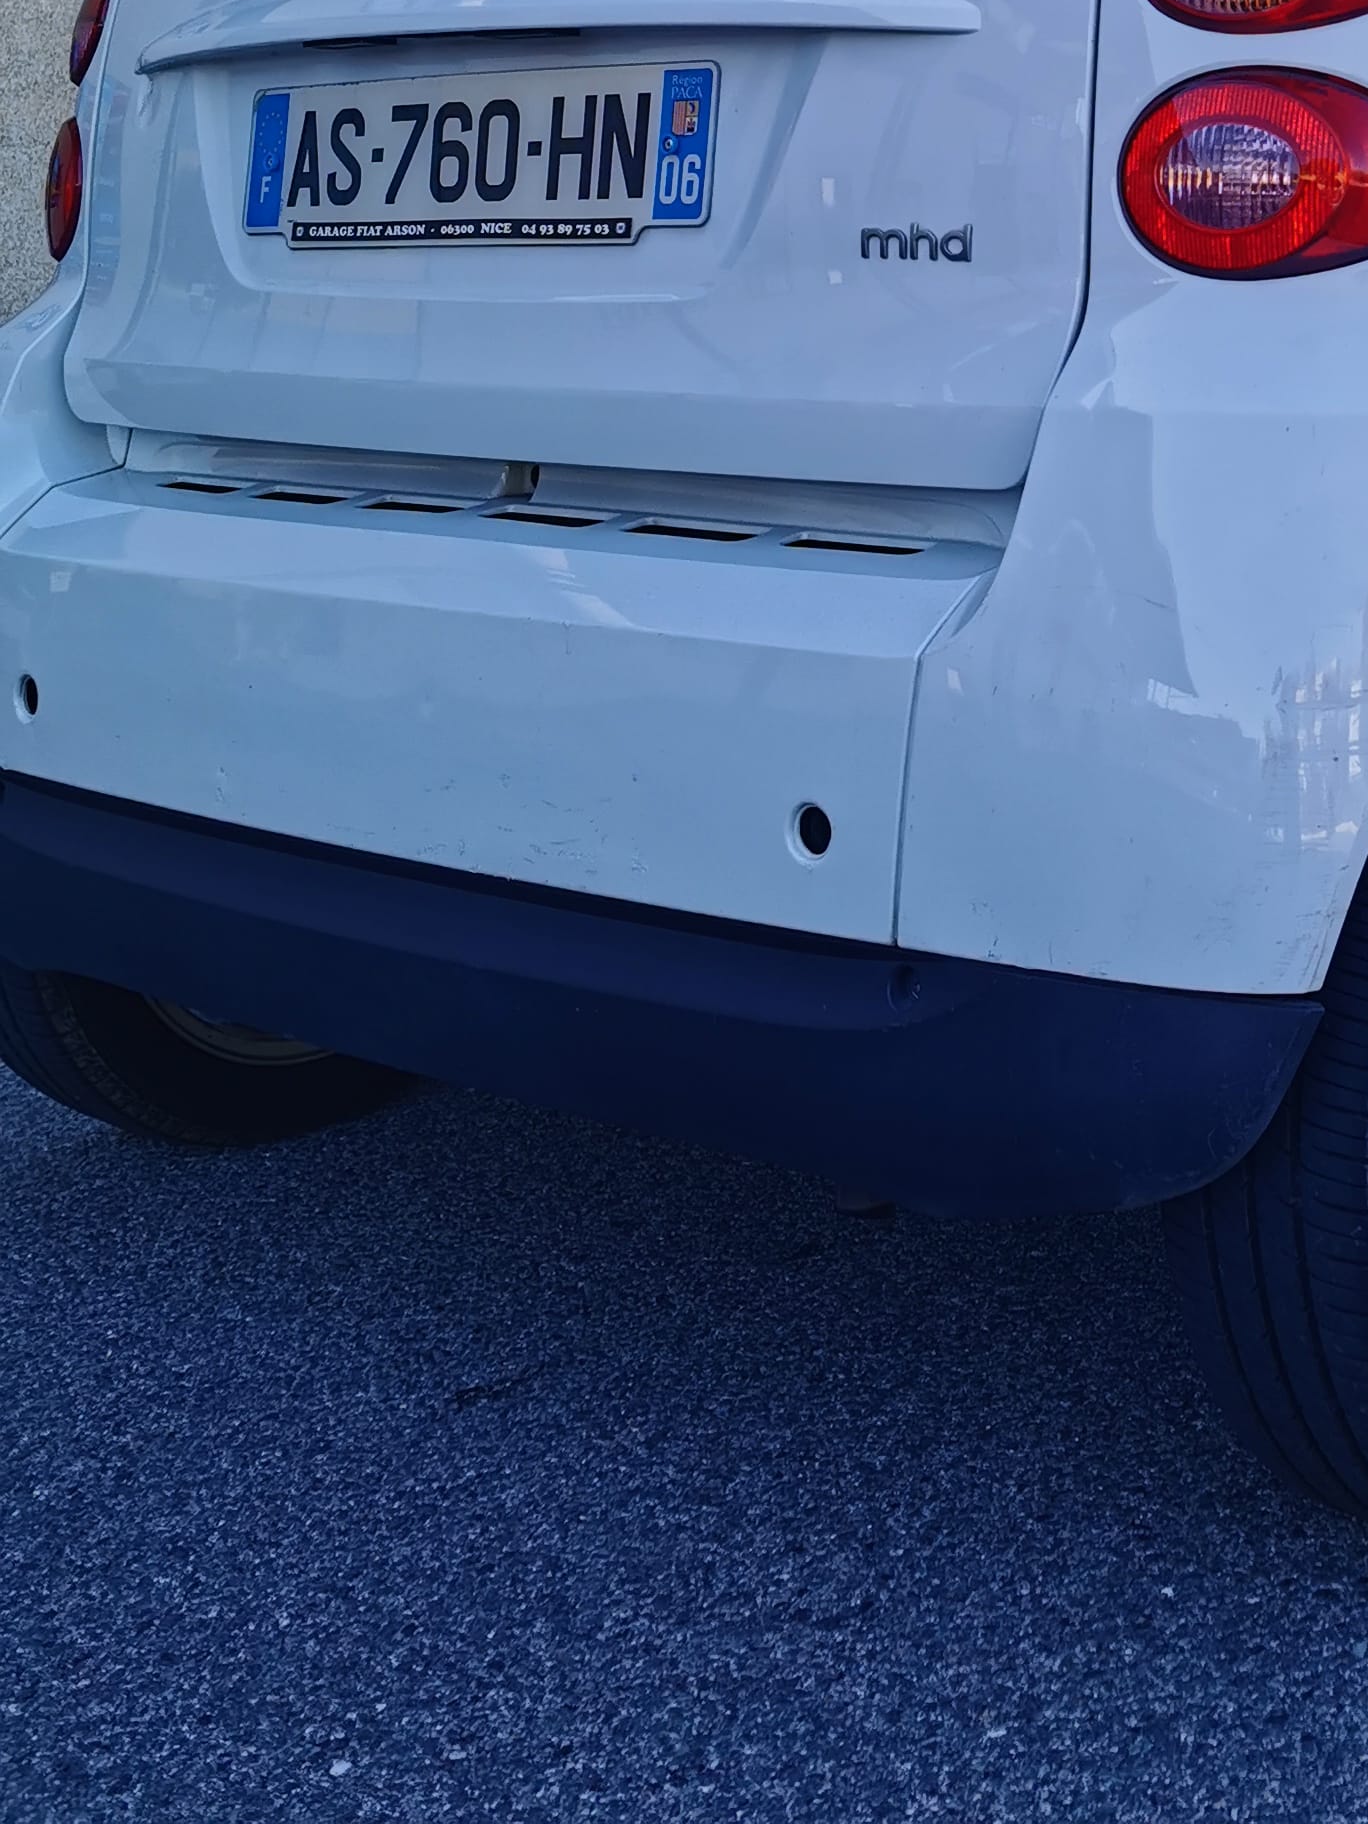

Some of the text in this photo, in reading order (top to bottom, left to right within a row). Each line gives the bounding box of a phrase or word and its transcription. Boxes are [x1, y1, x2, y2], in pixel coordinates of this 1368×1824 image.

[671, 86, 703, 99] PACA
[286, 92, 651, 207] AS-760-HN
[260, 176, 271, 203] F
[659, 154, 701, 205] 06
[309, 226, 354, 237] GARAGE
[356, 226, 383, 236] FIAT
[384, 225, 425, 236] ARSON
[440, 224, 474, 235] 06300
[480, 222, 512, 234] NICE
[521, 224, 536, 235] 04
[539, 224, 554, 235] 93
[557, 223, 572, 235] 89
[576, 224, 591, 235] 75
[594, 224, 610, 235] 03
[861, 222, 973, 263] mhd
